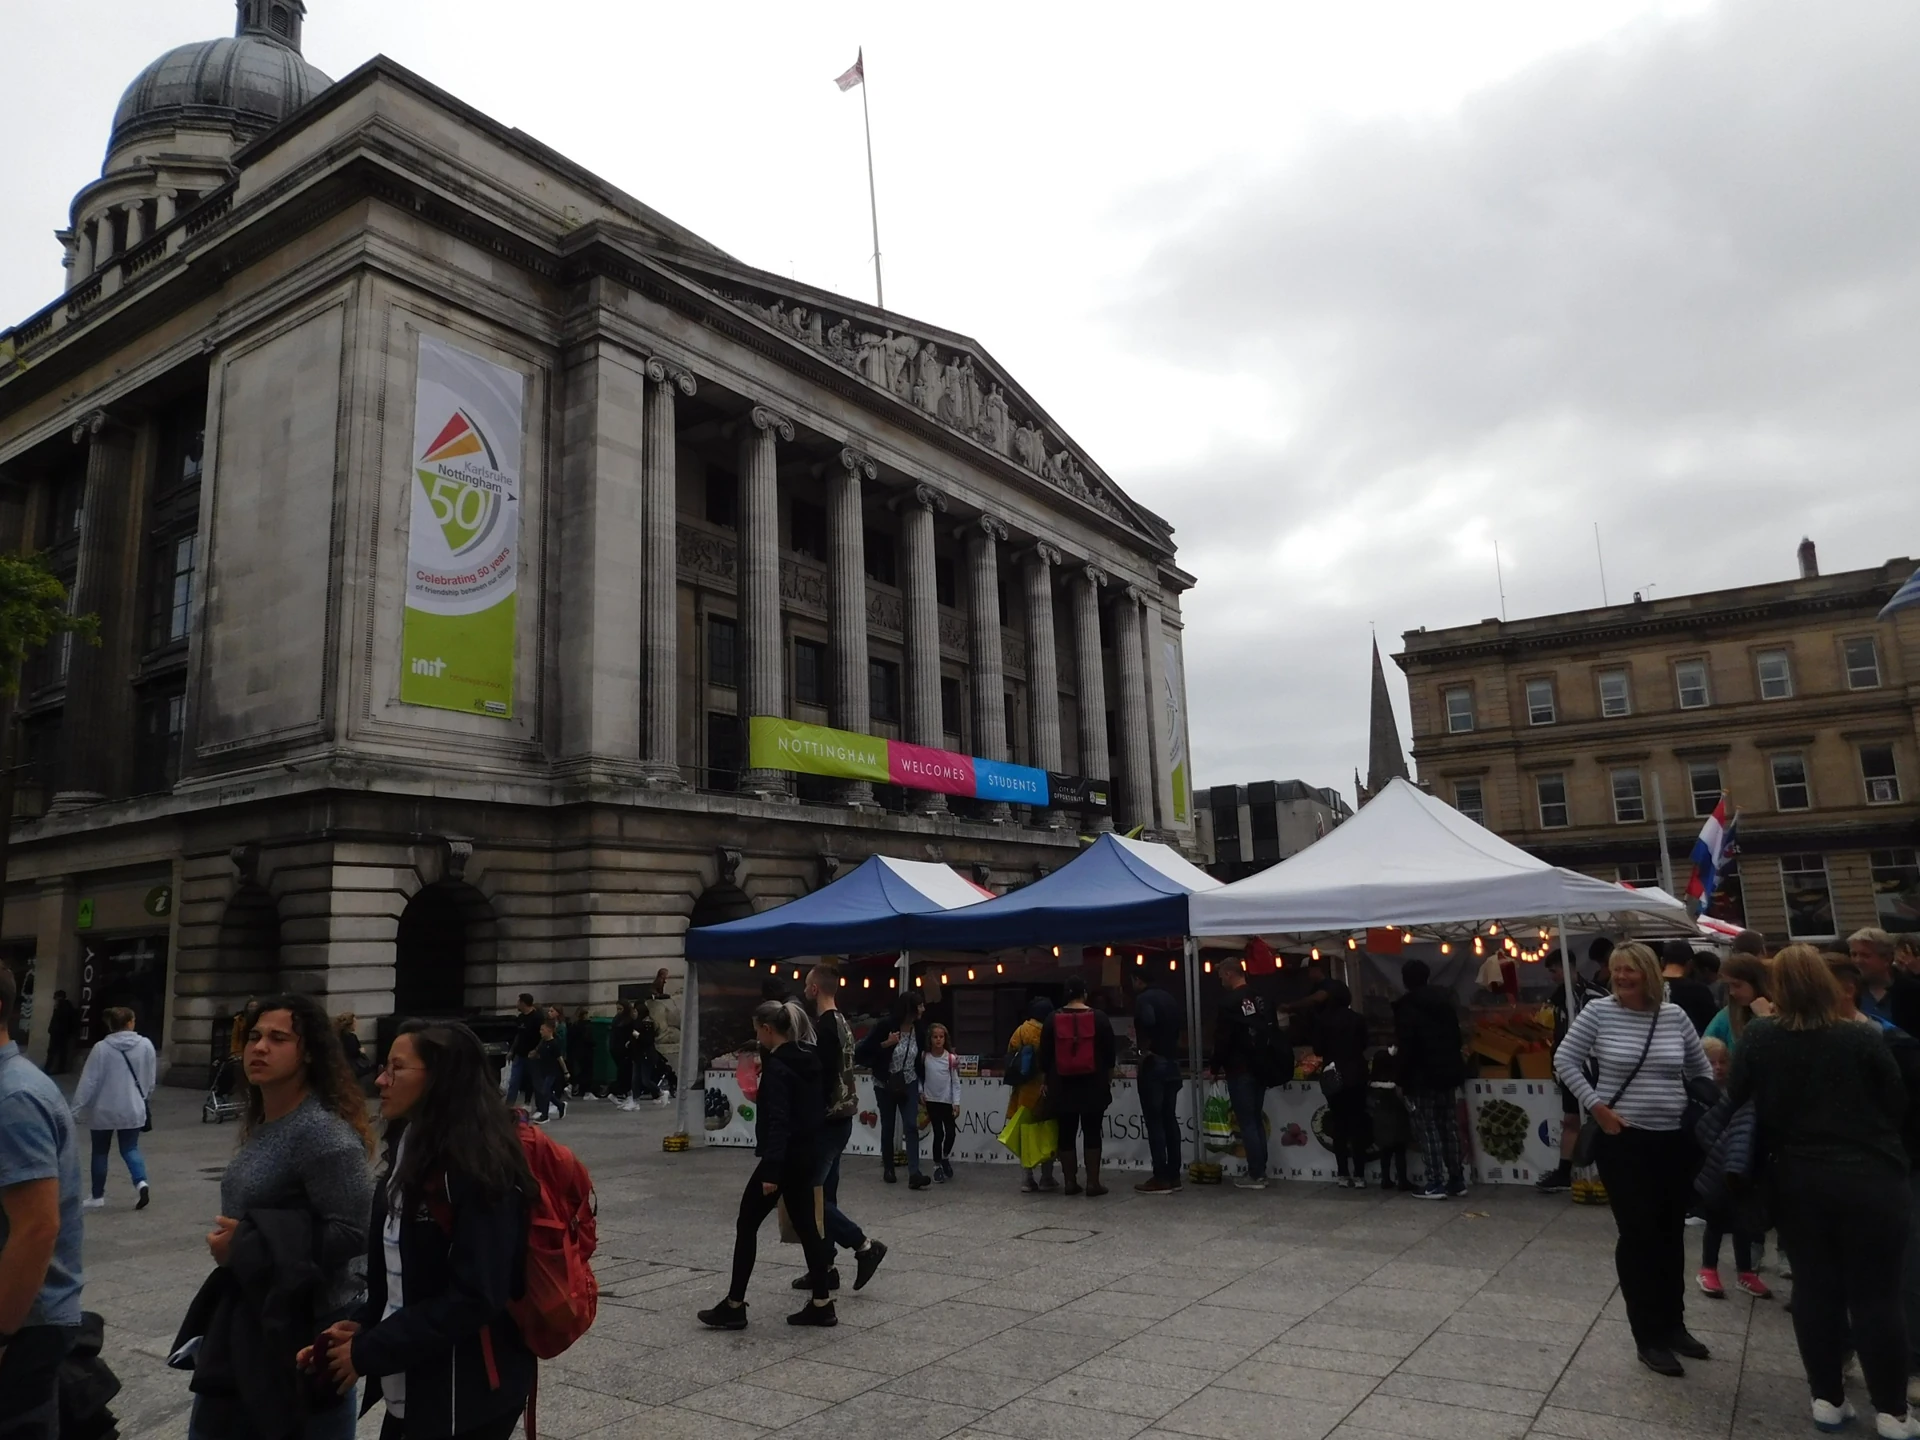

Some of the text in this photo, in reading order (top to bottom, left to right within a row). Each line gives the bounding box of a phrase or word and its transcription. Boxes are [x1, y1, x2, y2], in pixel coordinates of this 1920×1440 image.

[438, 463, 502, 494] Nottingham
[464, 461, 513, 486] Karlsruhe
[430, 477, 485, 531] 50
[416, 547, 510, 586] Celebrating 50 years
[425, 586, 460, 597] friendship
[461, 582, 488, 595] between
[411, 657, 447, 678] init
[778, 736, 877, 767] NOTTINGHAM
[902, 760, 965, 781] WELCOMES
[988, 774, 1037, 793] STUDENTS
[1058, 785, 1069, 793] CITY
[1053, 792, 1085, 803] OPPORTUNITY
[80, 946, 96, 1041] ENJOY
